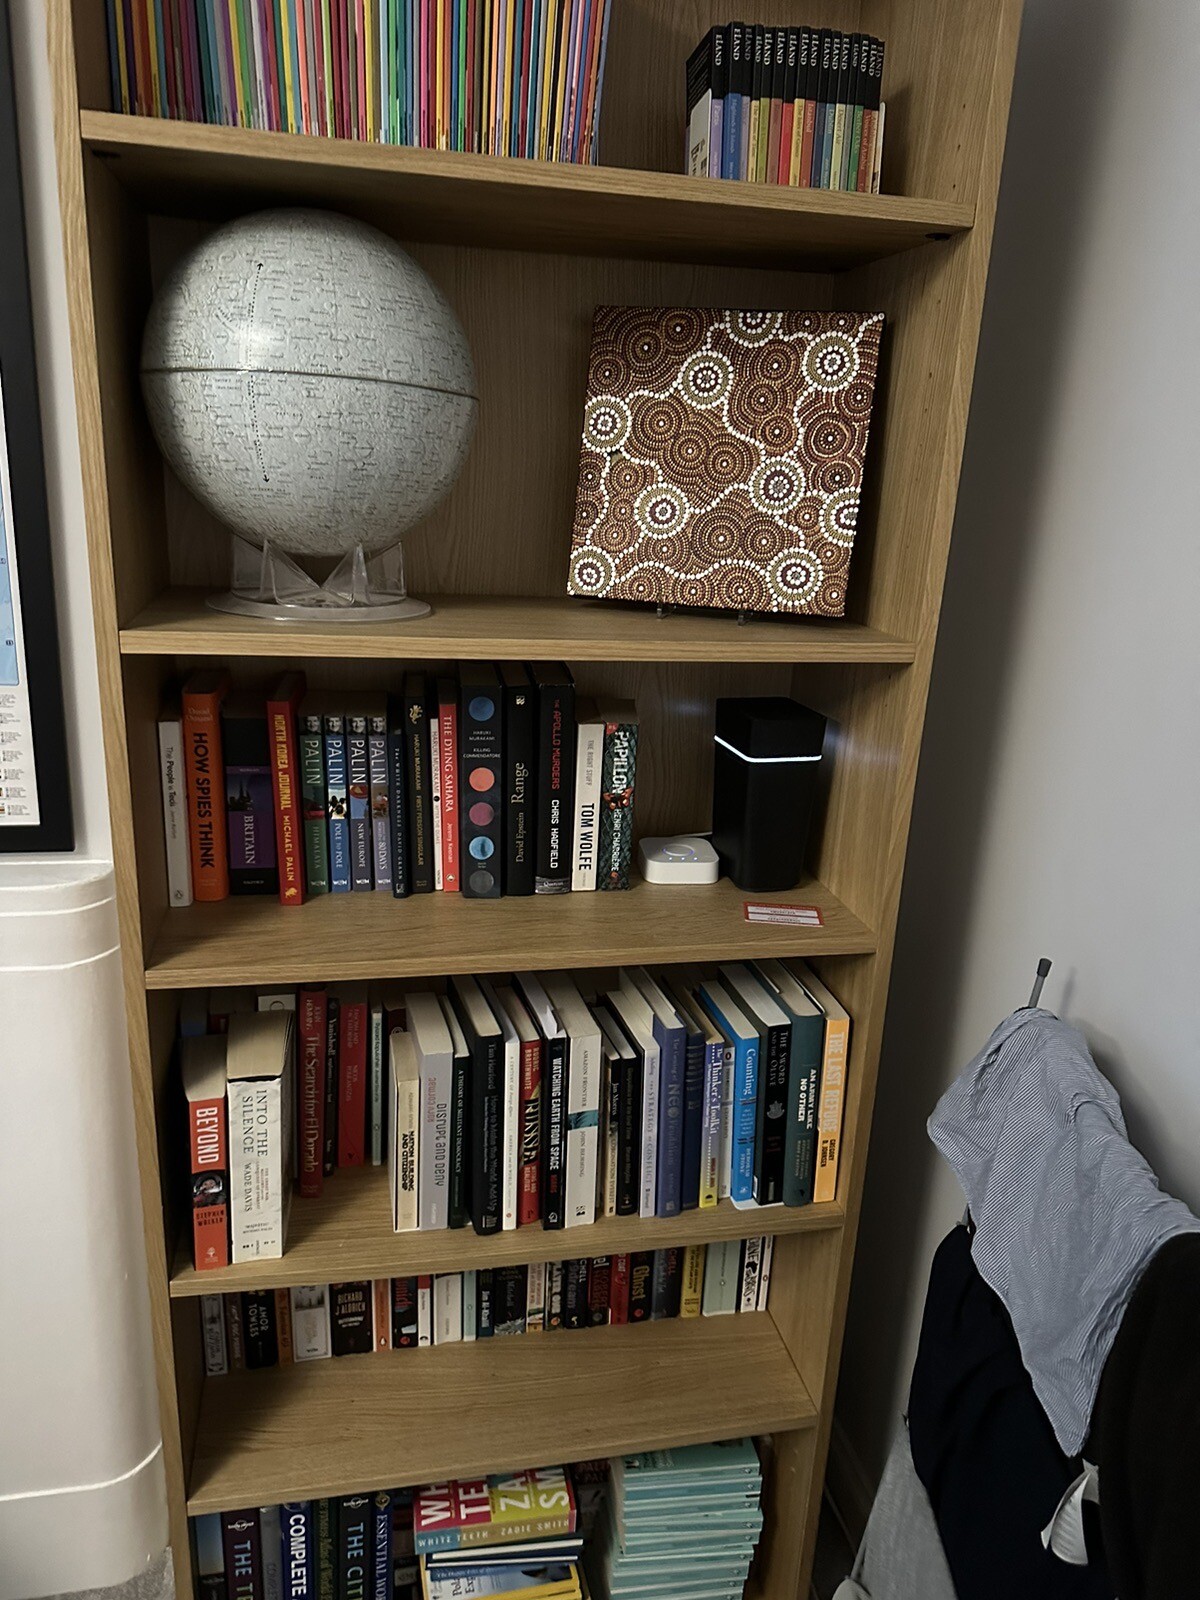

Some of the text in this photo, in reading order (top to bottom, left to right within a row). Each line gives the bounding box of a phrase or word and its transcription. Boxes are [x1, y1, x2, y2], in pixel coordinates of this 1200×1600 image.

[715, 34, 723, 66] ELAND
[733, 28, 741, 60] ELAND
[744, 28, 752, 60] ELAND
[764, 34, 772, 65] ELAND
[776, 32, 786, 64] ELAND
[788, 34, 797, 66] ELAND
[800, 34, 809, 65] ELAND
[810, 34, 818, 66] ELAND
[822, 38, 830, 68] ELAND
[832, 38, 840, 70] ELAND
[860, 40, 868, 72] ELAND
[869, 44, 877, 76] ELAND
[443, 715, 452, 735] THE
[193, 732, 210, 773] HOW
[305, 740, 320, 784] PALIN
[371, 740, 386, 784] PALIN
[444, 739, 454, 770] DYING
[586, 752, 594, 768] RIGHT
[612, 731, 630, 794] PAPILLON
[166, 761, 175, 784] People
[432, 759, 440, 793] MURAKAMI
[510, 763, 528, 804] Range
[550, 711, 562, 868] APOLLO MURDERS CHRIS HADFIELD
[196, 777, 212, 818] SPIES
[274, 714, 295, 881] NORTH KOREA JOURNAL MICHAEL PALIN
[328, 740, 342, 784] PALIN
[336, 851, 344, 868] POLE
[350, 740, 366, 784] PALIN
[358, 841, 366, 868] EUROPE
[444, 774, 454, 812] SAHARA
[446, 822, 454, 841] Jeremy
[580, 804, 595, 827] TOM
[612, 809, 622, 830] HENRI
[200, 822, 215, 868] THINK
[244, 815, 256, 864] BRITAIN
[516, 840, 524, 862] David
[579, 832, 593, 870] WOLFE
[524, 1049, 532, 1090] BRAITHWAITE
[744, 1048, 756, 1094] Counting
[768, 1060, 779, 1086] OLIVE
[778, 1030, 788, 1084] THE SWORD
[710, 1060, 722, 1102] Thinker's
[822, 1032, 844, 1134] THE LAST REFUGE
[304, 1036, 319, 1172] The Search for El Dorado
[550, 1057, 562, 1171] WATCHING EARTH FROM SPACE
[610, 1083, 620, 1116] Jan Morris
[798, 1078, 808, 1122] NO OTHER
[806, 1069, 818, 1130] AN ARMY LIKE
[196, 1107, 220, 1164] BEYOND
[242, 1096, 254, 1154] SILENCE
[256, 1090, 268, 1157] INTO THE
[710, 1104, 721, 1134] Toolkit
[820, 1146, 828, 1168] JOHNSEN
[828, 1139, 836, 1160] GREGORY
[244, 1162, 253, 1212] WADE DAVIS
[482, 1290, 490, 1301] Jim
[632, 1265, 650, 1301] Ghost
[248, 1304, 260, 1338] TOWLES
[259, 1306, 269, 1332] AMOR
[347, 1522, 364, 1560] THE
[376, 1514, 388, 1578] ESSENTIAL
[418, 1518, 569, 1548] WHITE TEETH ZADIE SMITH
[234, 1540, 252, 1576] THE
[290, 1514, 306, 1598] COMPLETE
